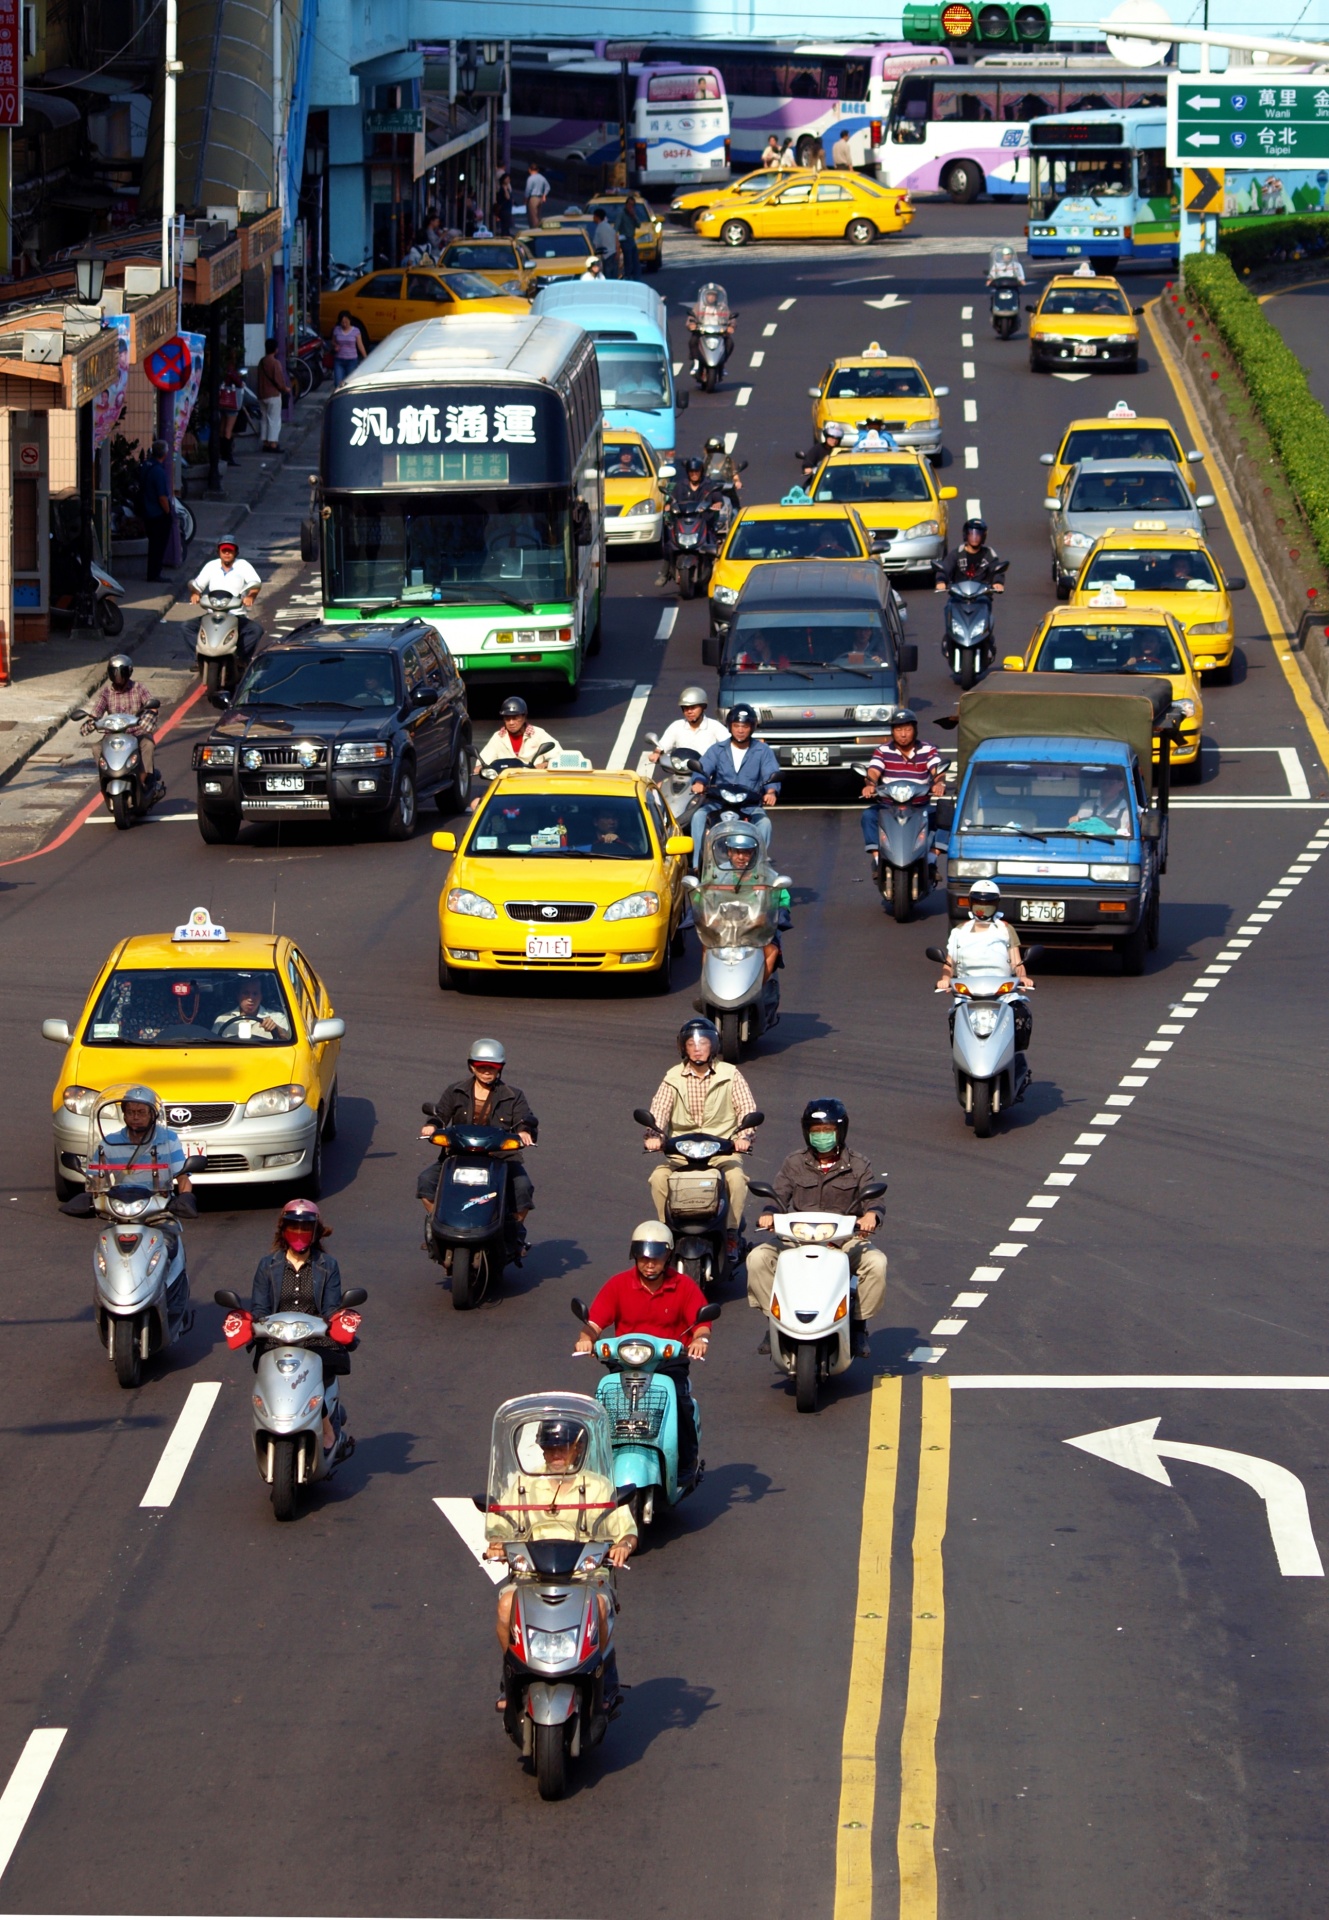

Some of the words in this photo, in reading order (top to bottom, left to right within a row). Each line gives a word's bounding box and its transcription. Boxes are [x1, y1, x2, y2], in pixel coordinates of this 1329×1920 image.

[1258, 88, 1298, 107] 萬里
[1265, 109, 1291, 118] Wanli
[1257, 127, 1298, 145] 台北
[1264, 145, 1291, 156] Taipei
[472, 454, 501, 465] 台北
